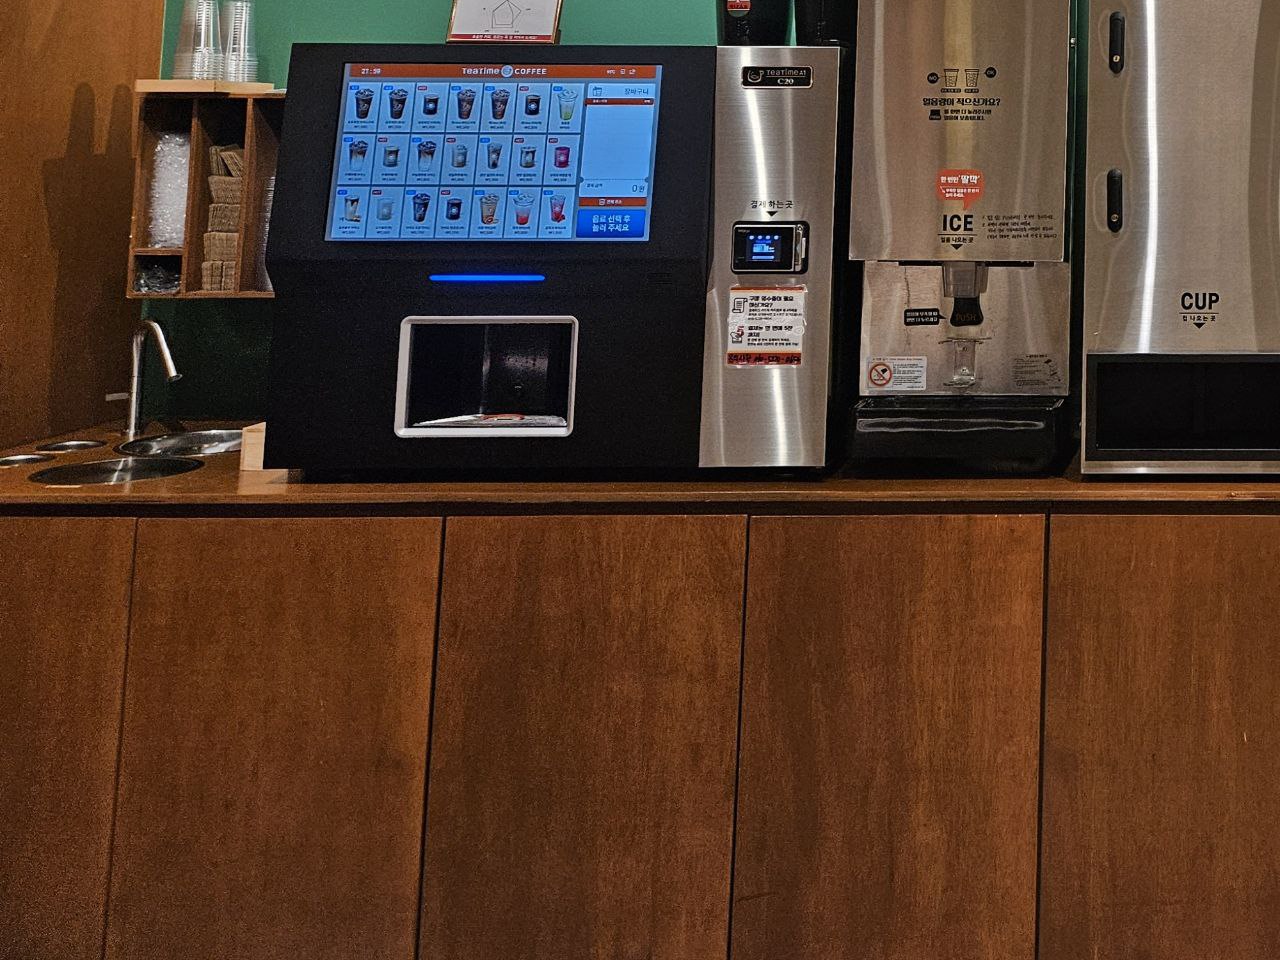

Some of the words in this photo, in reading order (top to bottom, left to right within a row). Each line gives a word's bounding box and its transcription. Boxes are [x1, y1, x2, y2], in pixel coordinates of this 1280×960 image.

[462, 67, 500, 75] TeaTime
[777, 77, 794, 85] C20
[624, 87, 649, 96] 장바구니
[956, 97, 1001, 106] 적으신가요?
[768, 200, 784, 209] 하는
[785, 200, 794, 209] 곳
[592, 214, 606, 224] 음료
[608, 215, 622, 223] 선택
[623, 215, 631, 223] 후
[942, 214, 973, 232] ICE
[592, 224, 607, 232] 눌러
[608, 224, 629, 232] 주세요
[1181, 292, 1219, 310] CUP
[956, 313, 976, 321] PUSH
